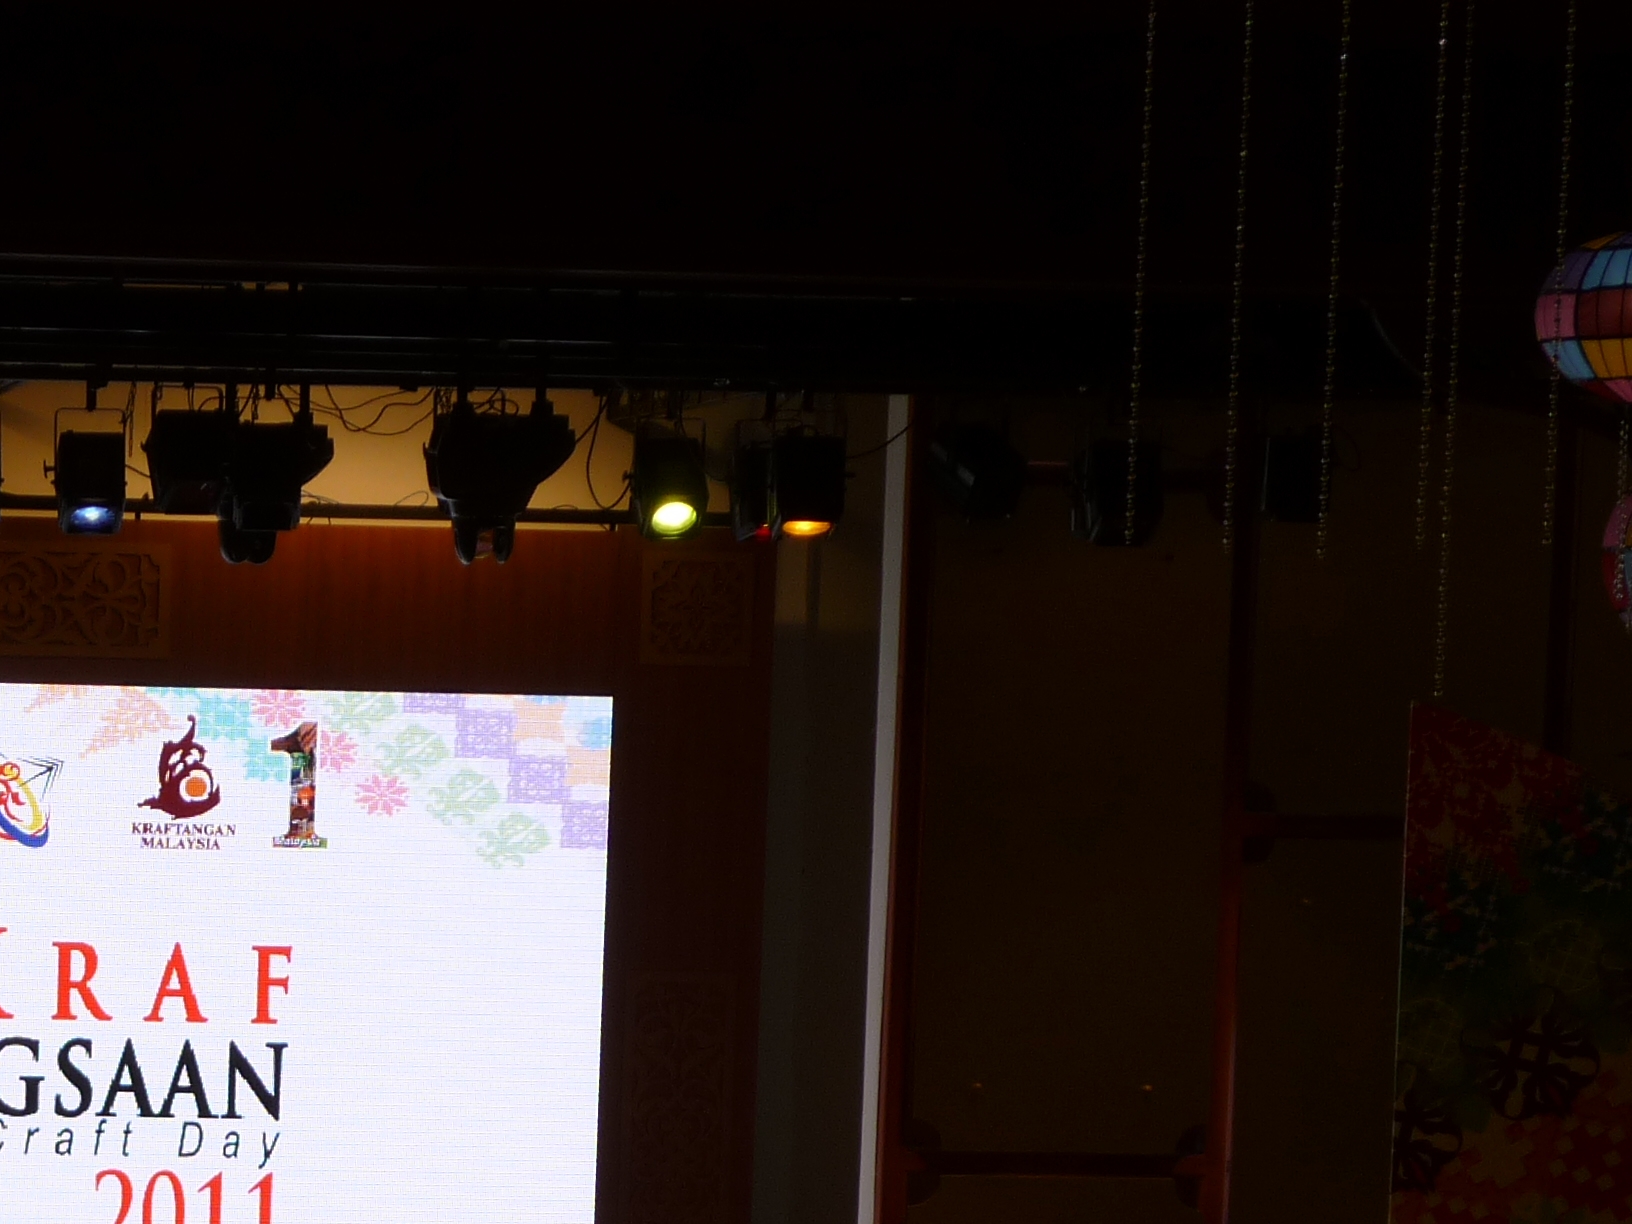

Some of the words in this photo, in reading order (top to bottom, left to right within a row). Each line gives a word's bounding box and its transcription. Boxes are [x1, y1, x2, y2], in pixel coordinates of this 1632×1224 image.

[131, 822, 236, 836] KRAFTANGAN
[140, 837, 221, 850] MALAYSIA
[177, 1120, 280, 1169] Day
